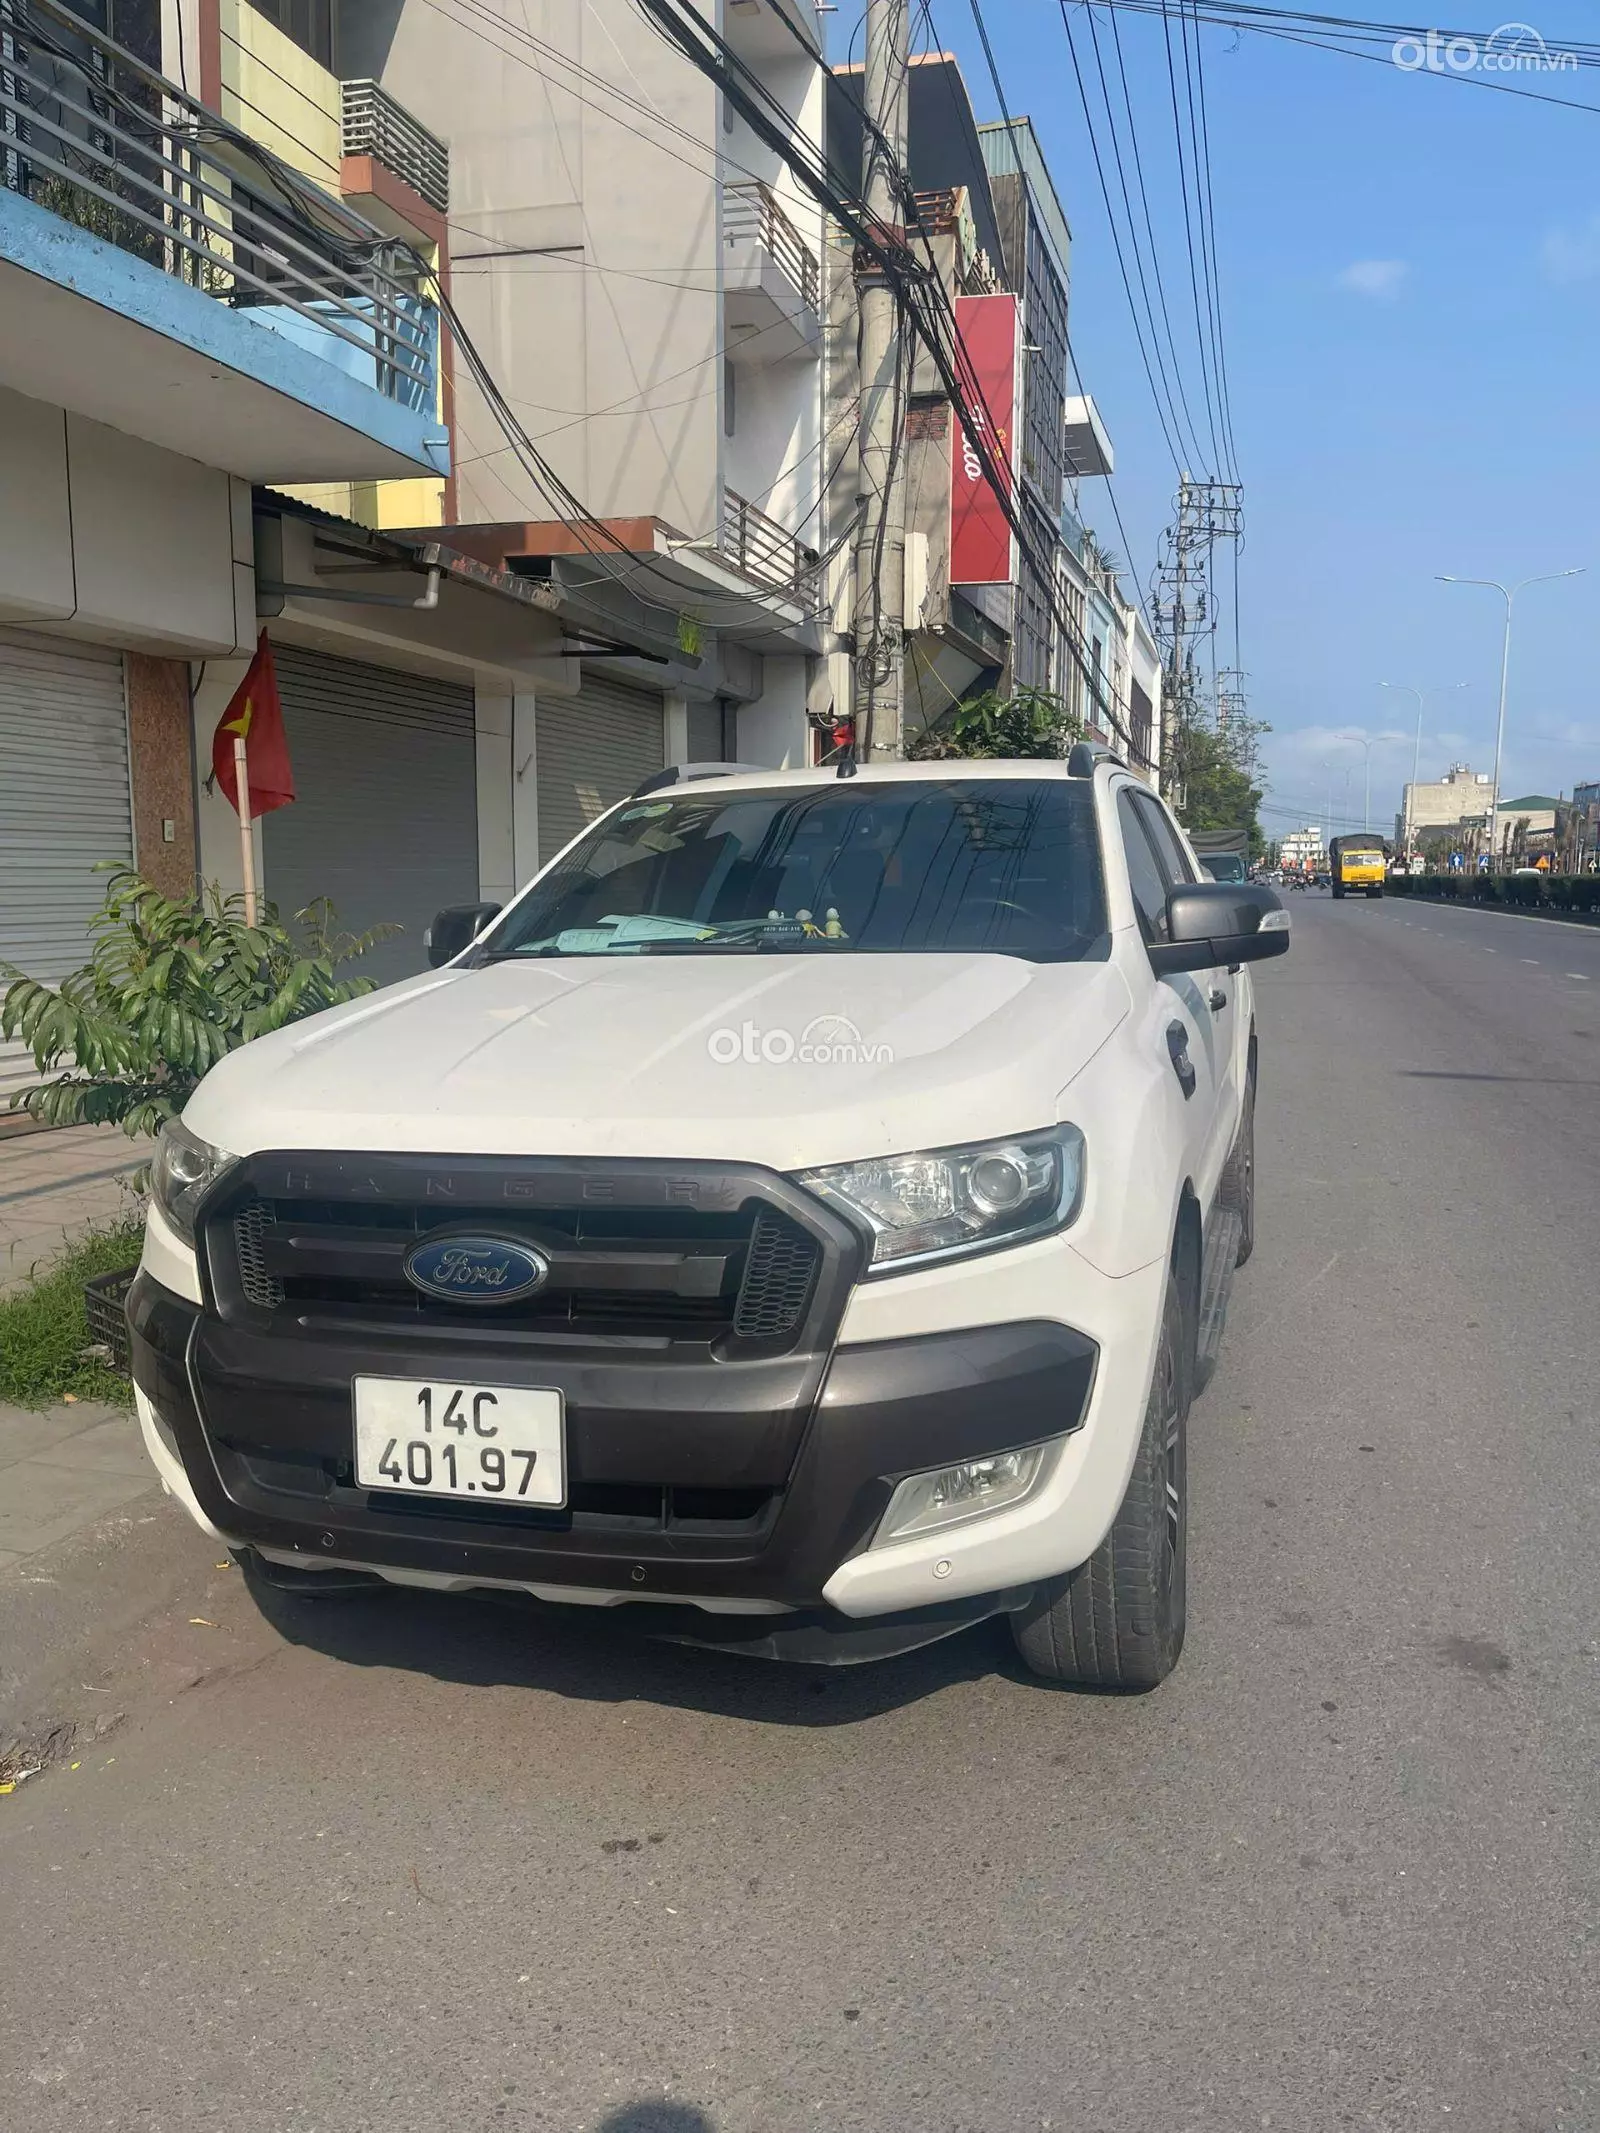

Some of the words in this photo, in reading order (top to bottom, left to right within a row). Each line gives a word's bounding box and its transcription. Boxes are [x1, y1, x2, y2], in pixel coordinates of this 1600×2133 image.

[432, 1248, 510, 1286] Ford
[418, 1387, 499, 1438] 14C
[378, 1438, 538, 1496] 401.97
